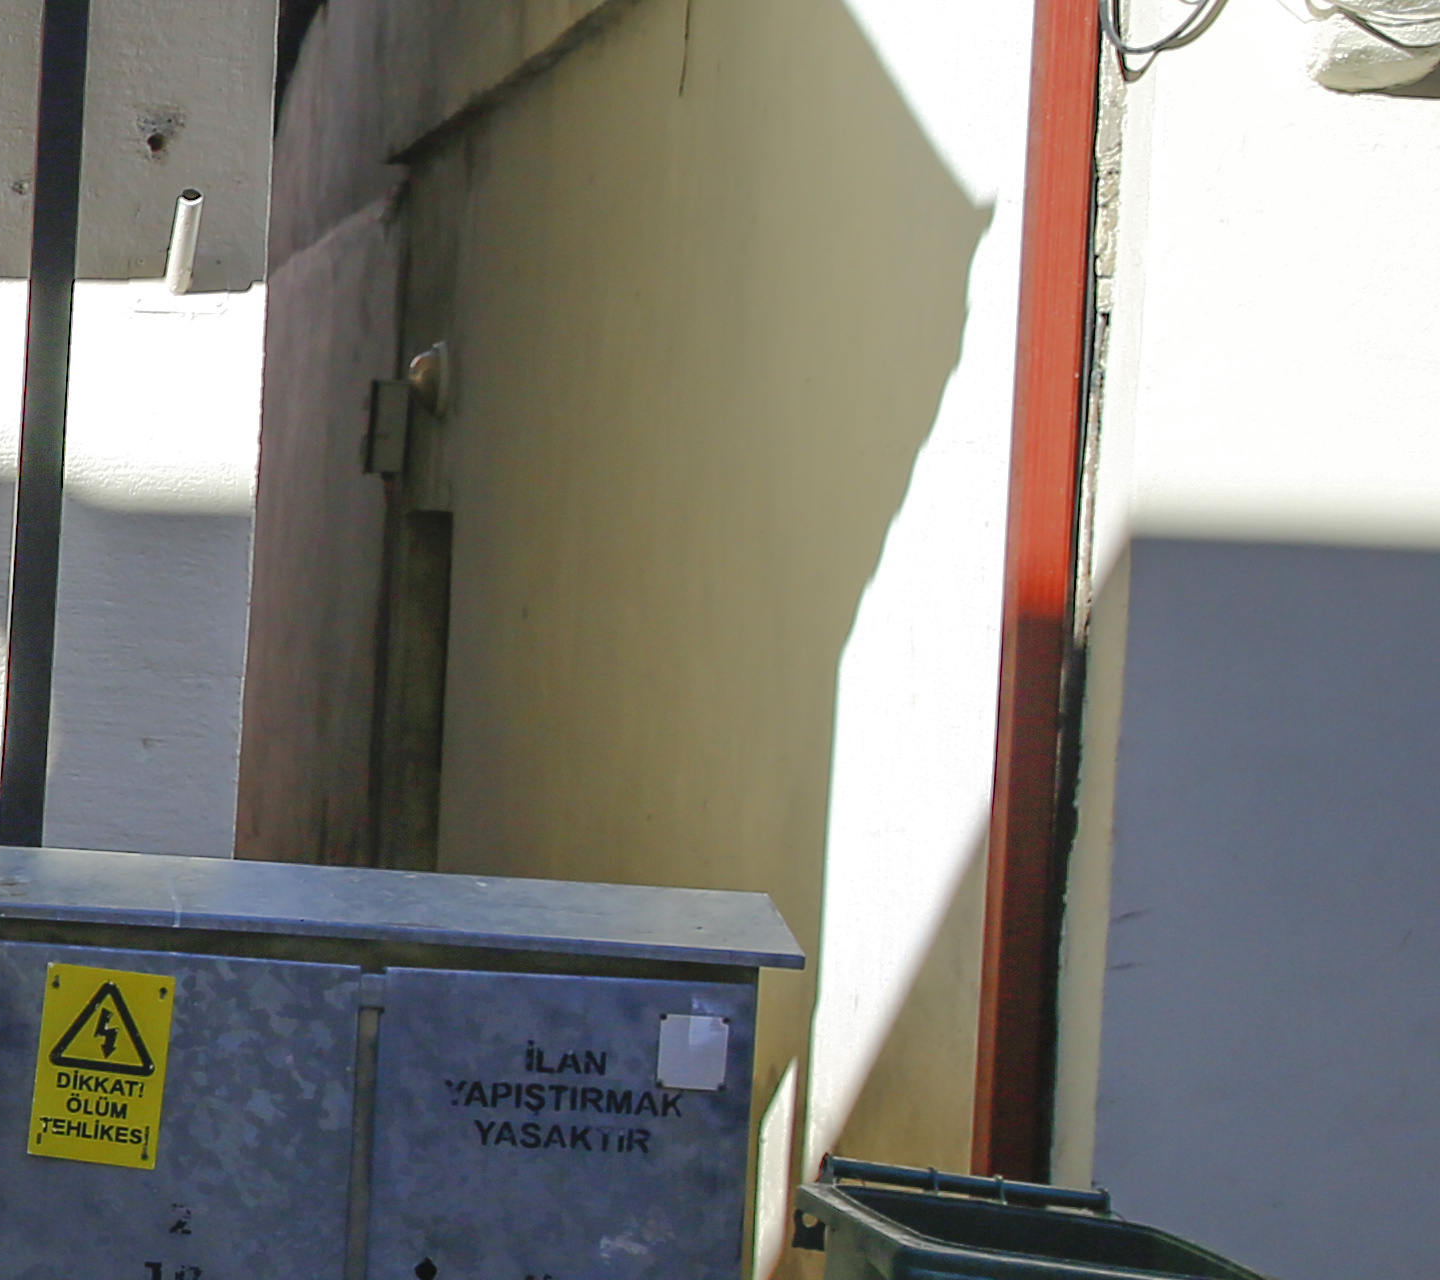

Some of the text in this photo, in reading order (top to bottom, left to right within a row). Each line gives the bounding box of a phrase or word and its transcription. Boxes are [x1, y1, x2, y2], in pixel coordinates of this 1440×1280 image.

[526, 1040, 607, 1076] İLAN
[56, 1070, 145, 1098] DİKKAT!
[445, 1080, 683, 1118] YAPIŞTIRMAK
[66, 1093, 128, 1119] ÖLÜM
[40, 1117, 149, 1147] TEHLİKESİ
[475, 1120, 650, 1154] YASAKTIR
